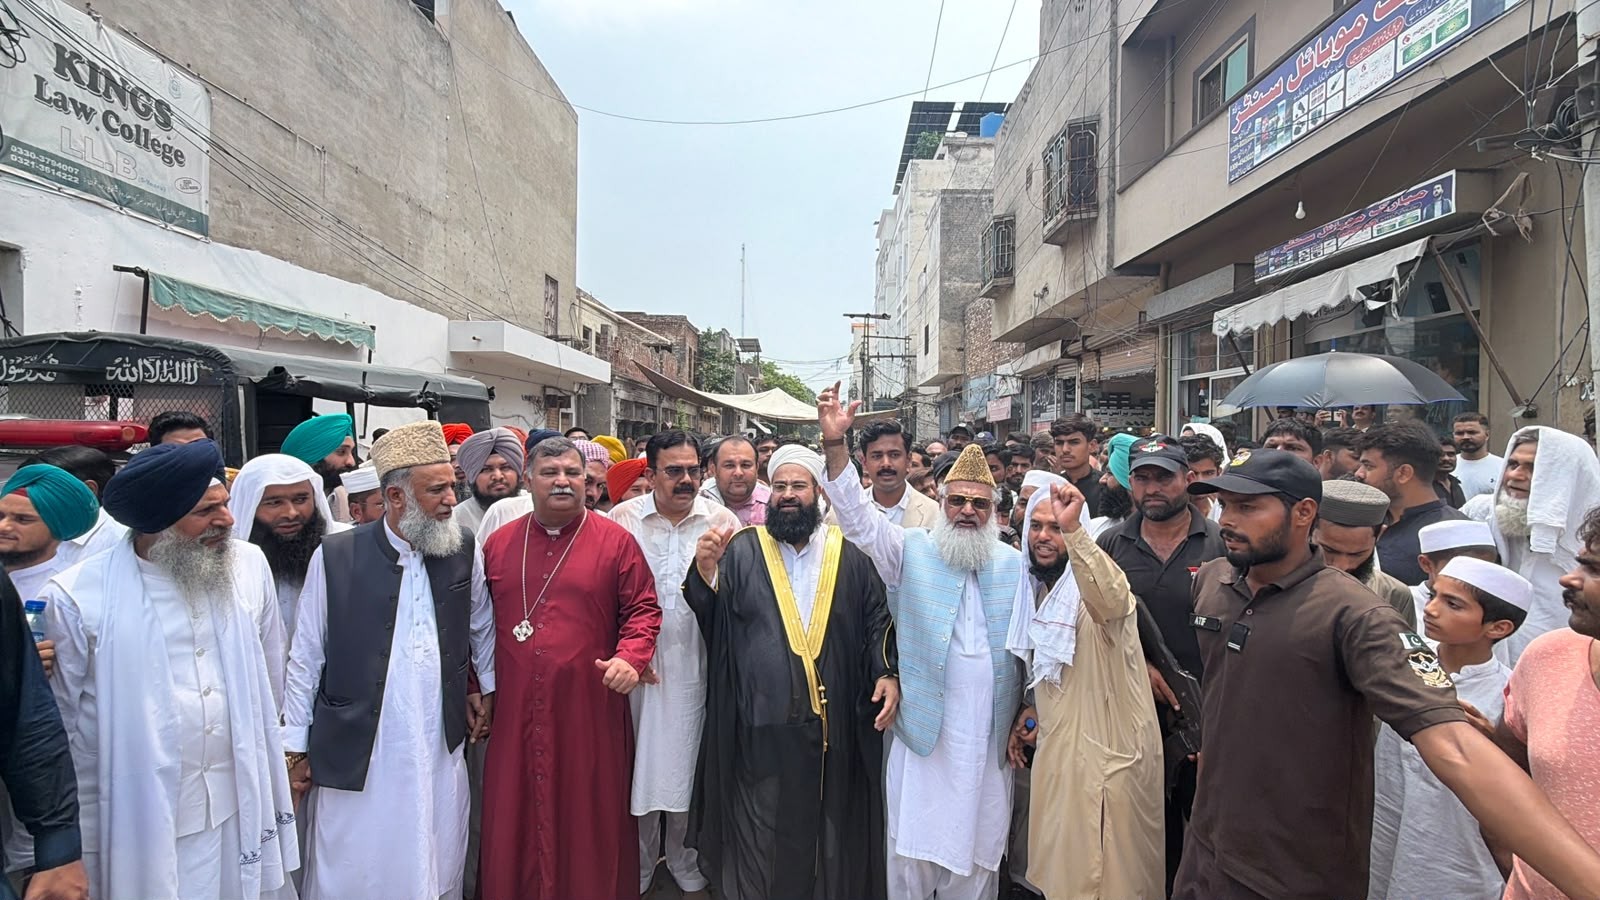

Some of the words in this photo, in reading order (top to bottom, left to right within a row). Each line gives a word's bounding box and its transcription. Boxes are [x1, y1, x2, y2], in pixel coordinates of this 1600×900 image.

[34, 73, 98, 125] Law
[102, 108, 186, 168] College
[53, 42, 174, 131] KINGS
